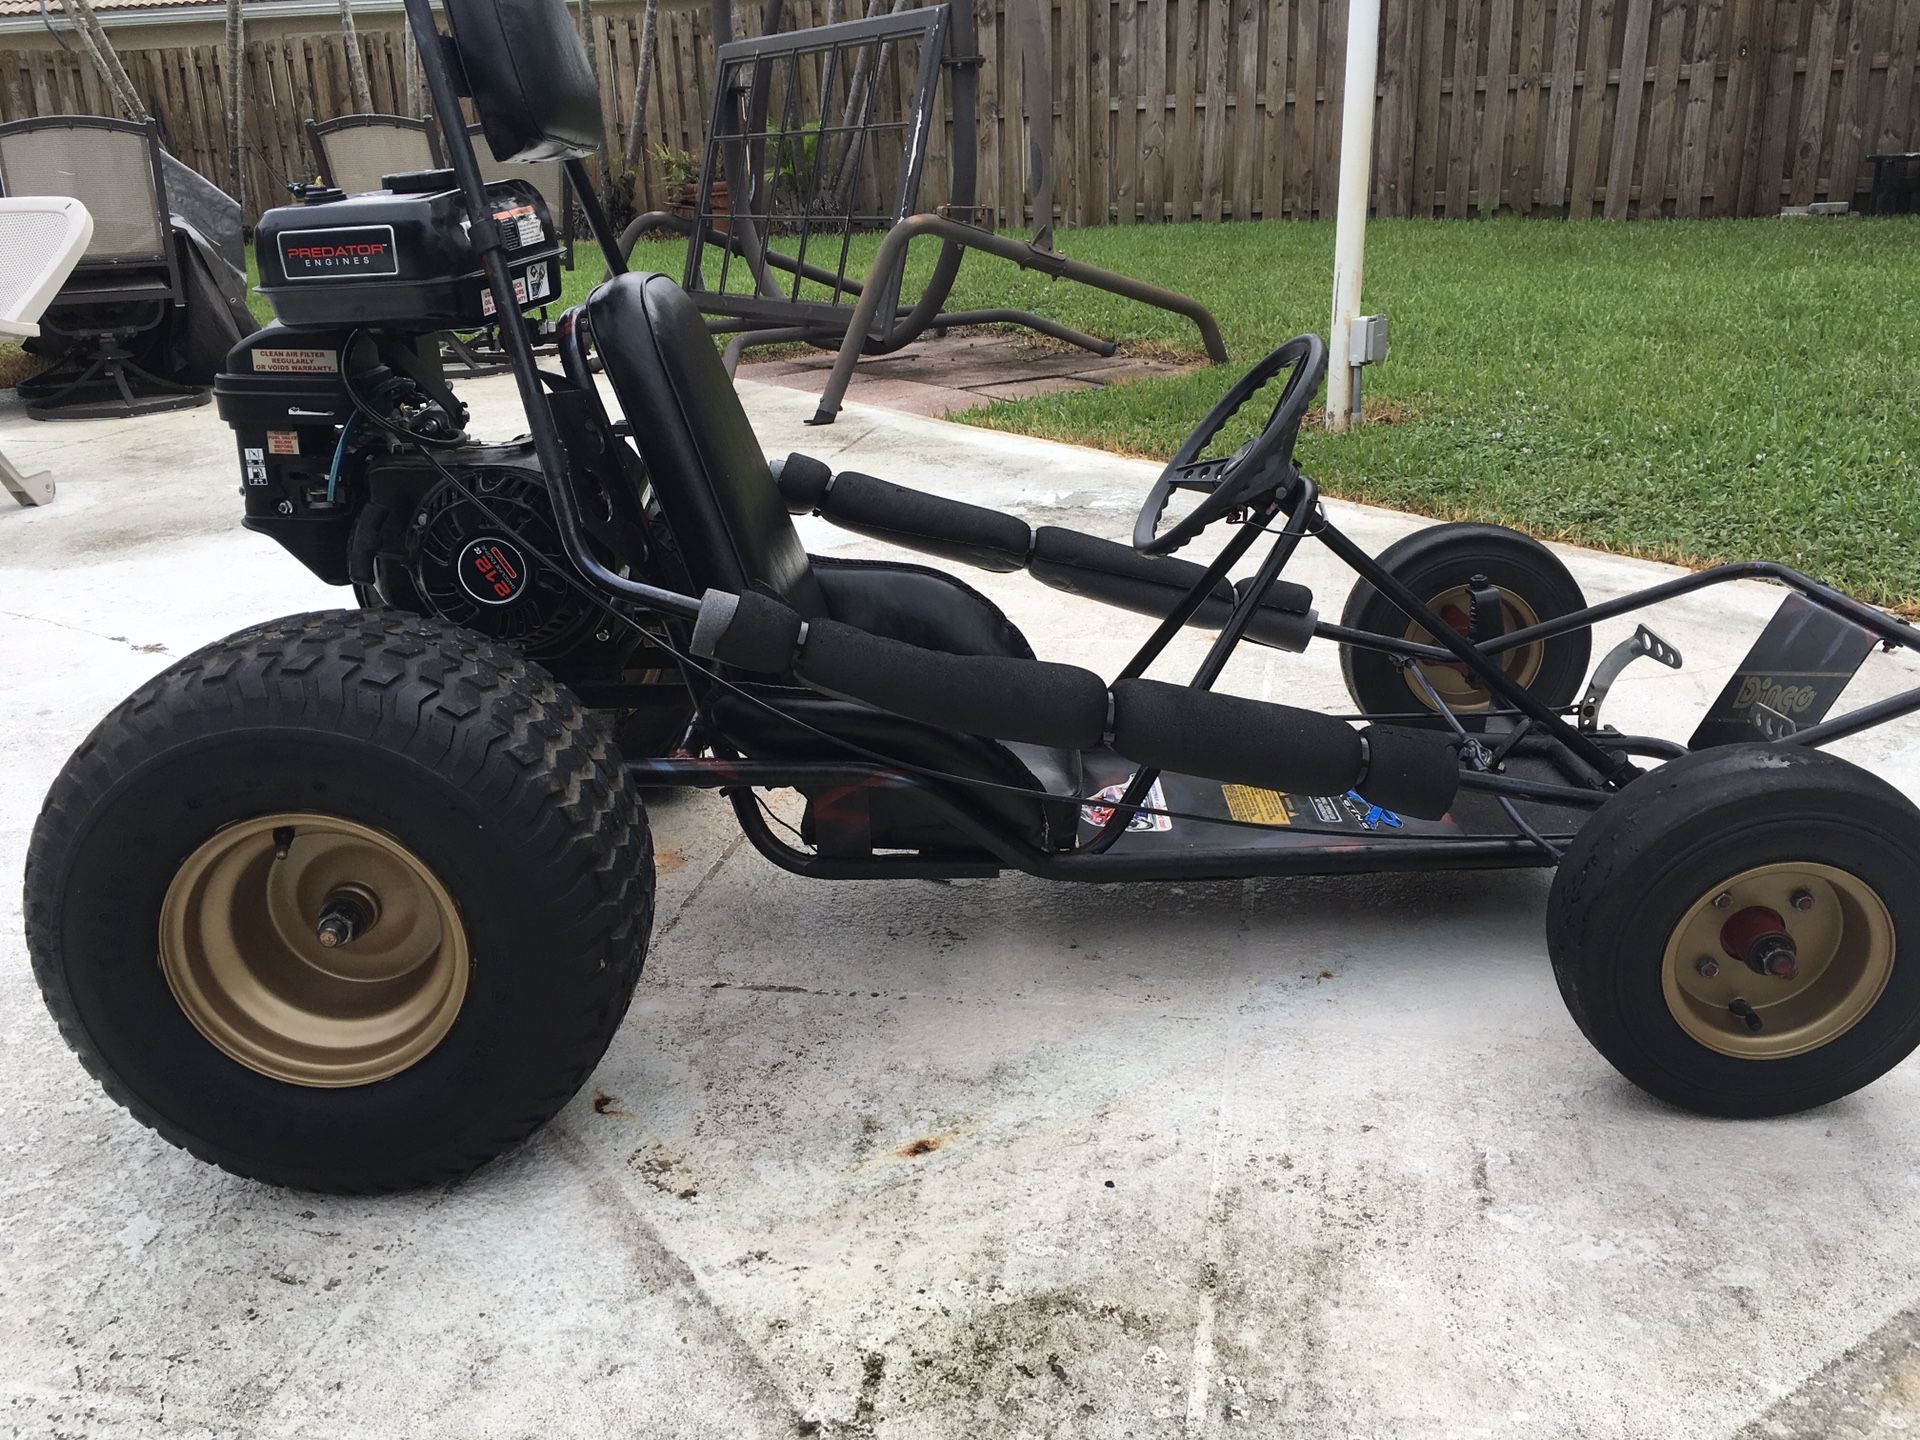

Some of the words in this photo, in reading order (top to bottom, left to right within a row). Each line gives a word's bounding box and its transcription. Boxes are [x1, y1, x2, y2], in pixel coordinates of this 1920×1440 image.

[287, 243, 385, 259] PREDATOR
[305, 256, 370, 267] ENGINES
[474, 555, 512, 597] 212
